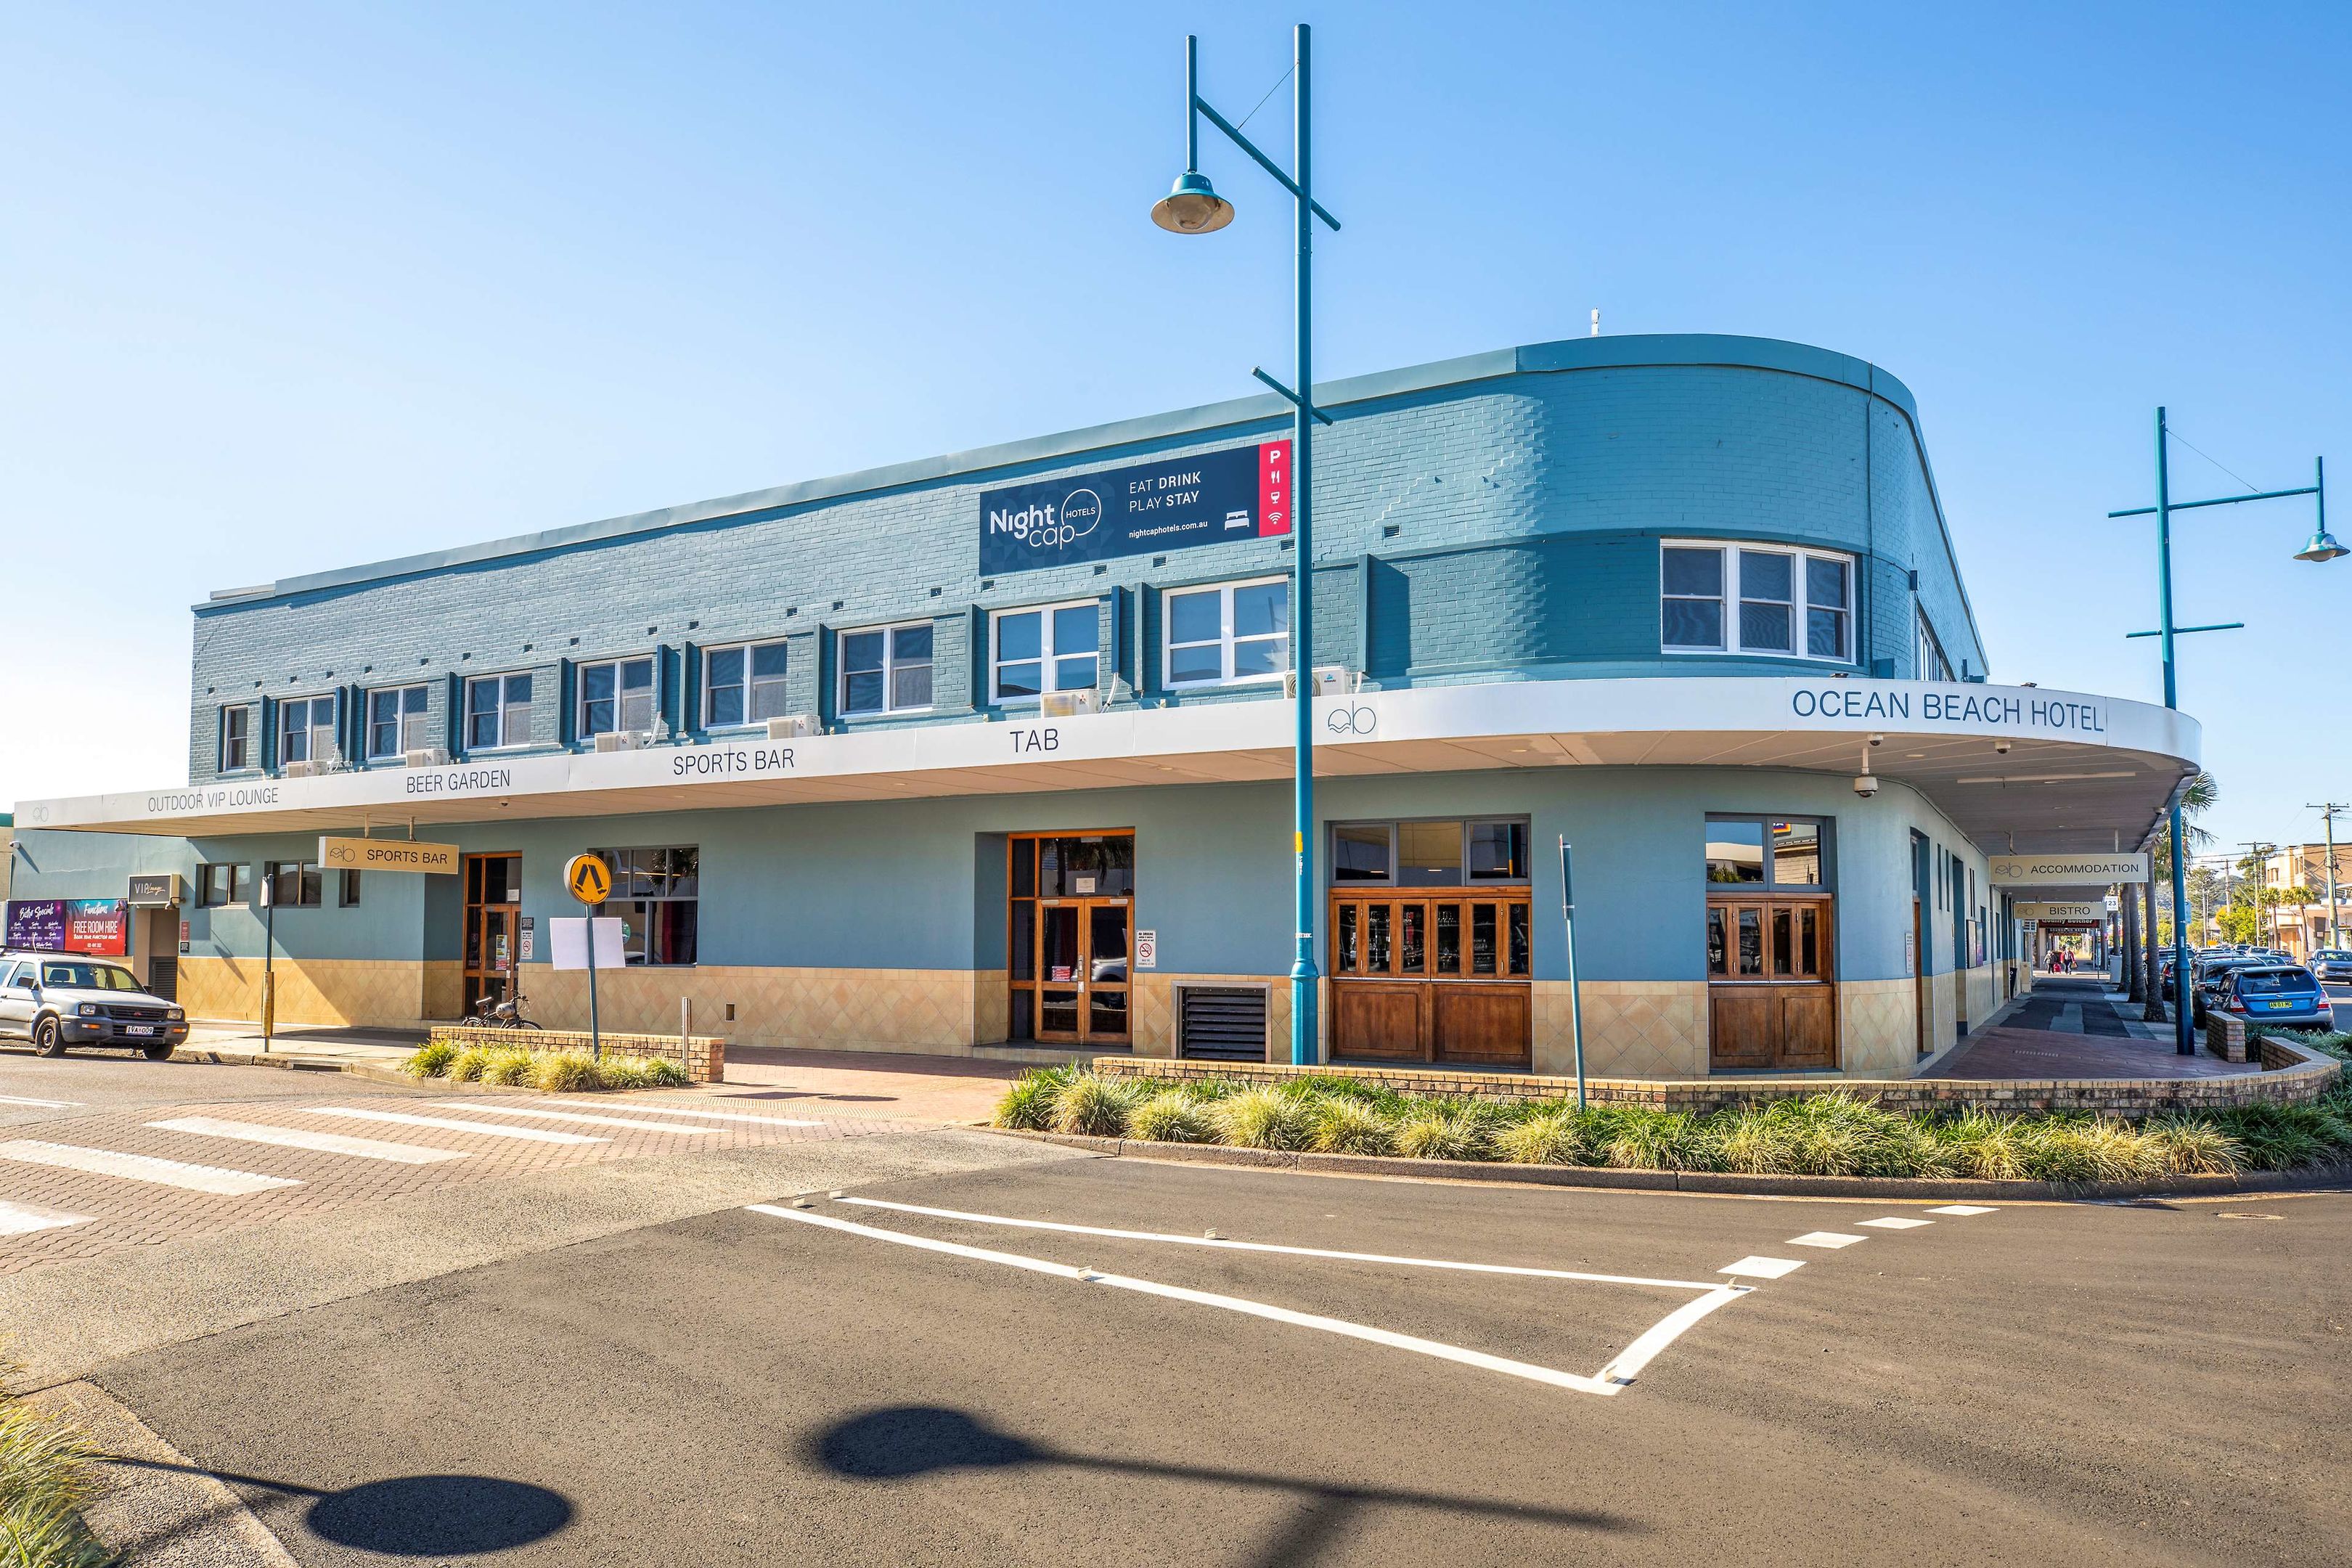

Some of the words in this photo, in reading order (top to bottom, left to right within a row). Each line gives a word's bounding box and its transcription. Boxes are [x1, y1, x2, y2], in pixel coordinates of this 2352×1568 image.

[1130, 479, 1153, 494] EAT
[1159, 471, 1201, 489] DRINK
[1066, 507, 1096, 518] HOTELS
[1130, 497, 1162, 513] PLAY
[1166, 491, 1200, 507] STAY
[990, 504, 1055, 539] Night
[1128, 520, 1208, 539] nightcaphotels.com.au
[1029, 525, 1075, 550] cap
[1792, 690, 1909, 719] OCEAN
[1923, 693, 2021, 724] BEACH
[2031, 699, 2104, 732] HOTEL
[1010, 728, 1059, 753] TAB
[673, 751, 748, 775] SPORTS
[754, 748, 795, 771] BAR
[407, 775, 444, 793] BEER
[448, 769, 510, 791] GARDEN
[147, 793, 203, 812] OUTDOOR
[208, 793, 226, 808] VIP
[229, 788, 279, 807] LOUNGE
[367, 849, 418, 863] SPORTS
[422, 852, 448, 865] BAR
[2030, 864, 2139, 874] ACCOMMODATION
[134, 883, 149, 894] VIP
[2049, 906, 2091, 915] BISTRO
[73, 920, 87, 934] FREE
[87, 920, 105, 934] ROOM
[105, 920, 118, 934] HIRE
